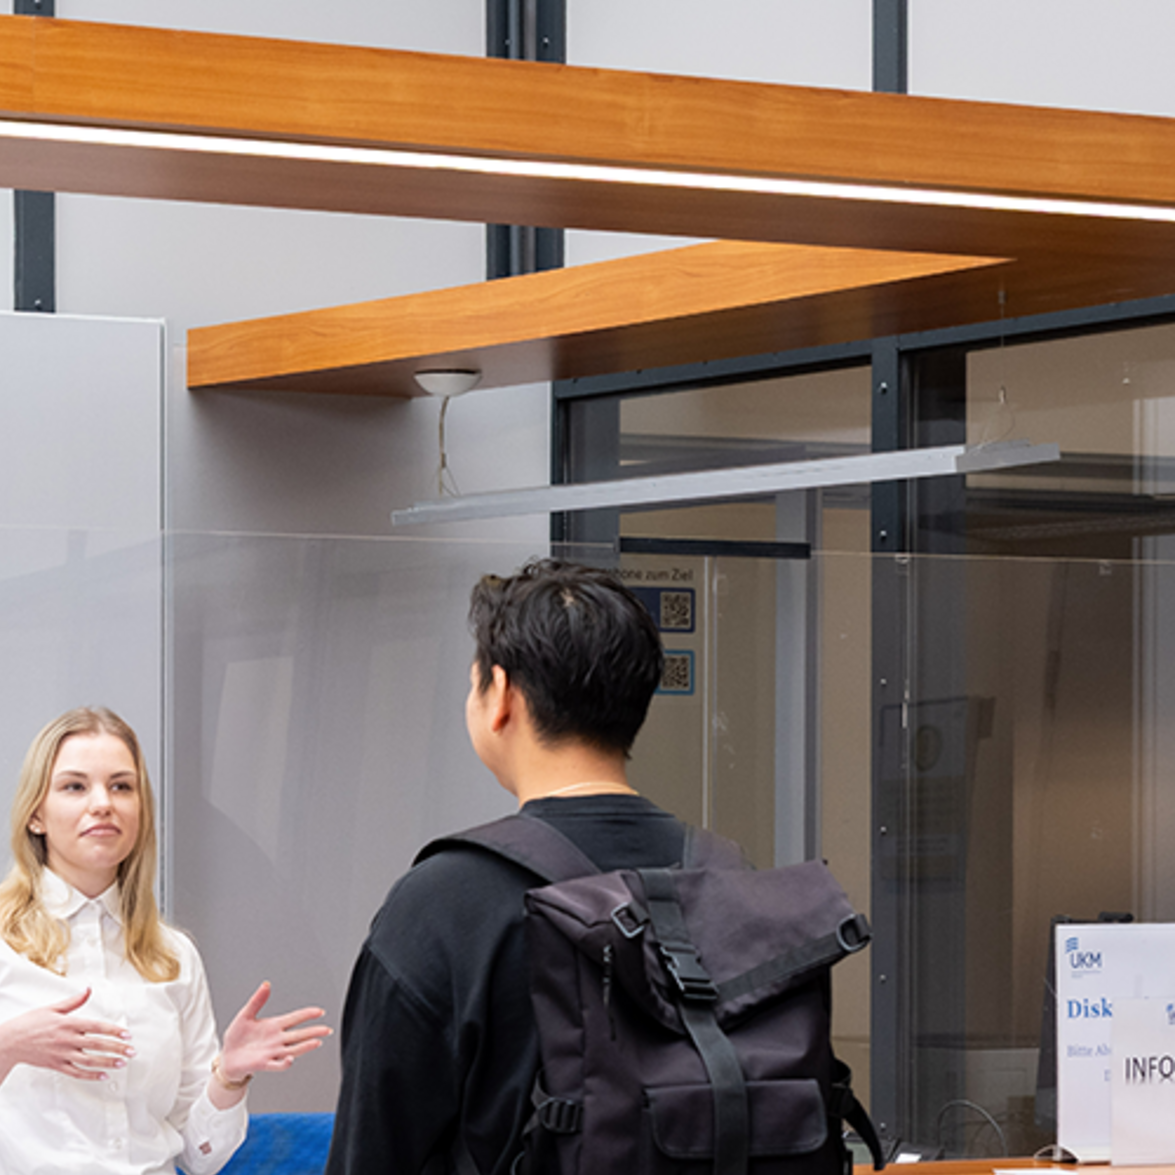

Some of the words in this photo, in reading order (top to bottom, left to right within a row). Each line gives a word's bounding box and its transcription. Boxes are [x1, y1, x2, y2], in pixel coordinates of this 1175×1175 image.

[645, 570, 669, 580] zum
[671, 567, 694, 581] Ziel
[1069, 952, 1102, 969] UKM
[1067, 997, 1112, 1018] Disk
[1125, 1055, 1175, 1079] INFO
